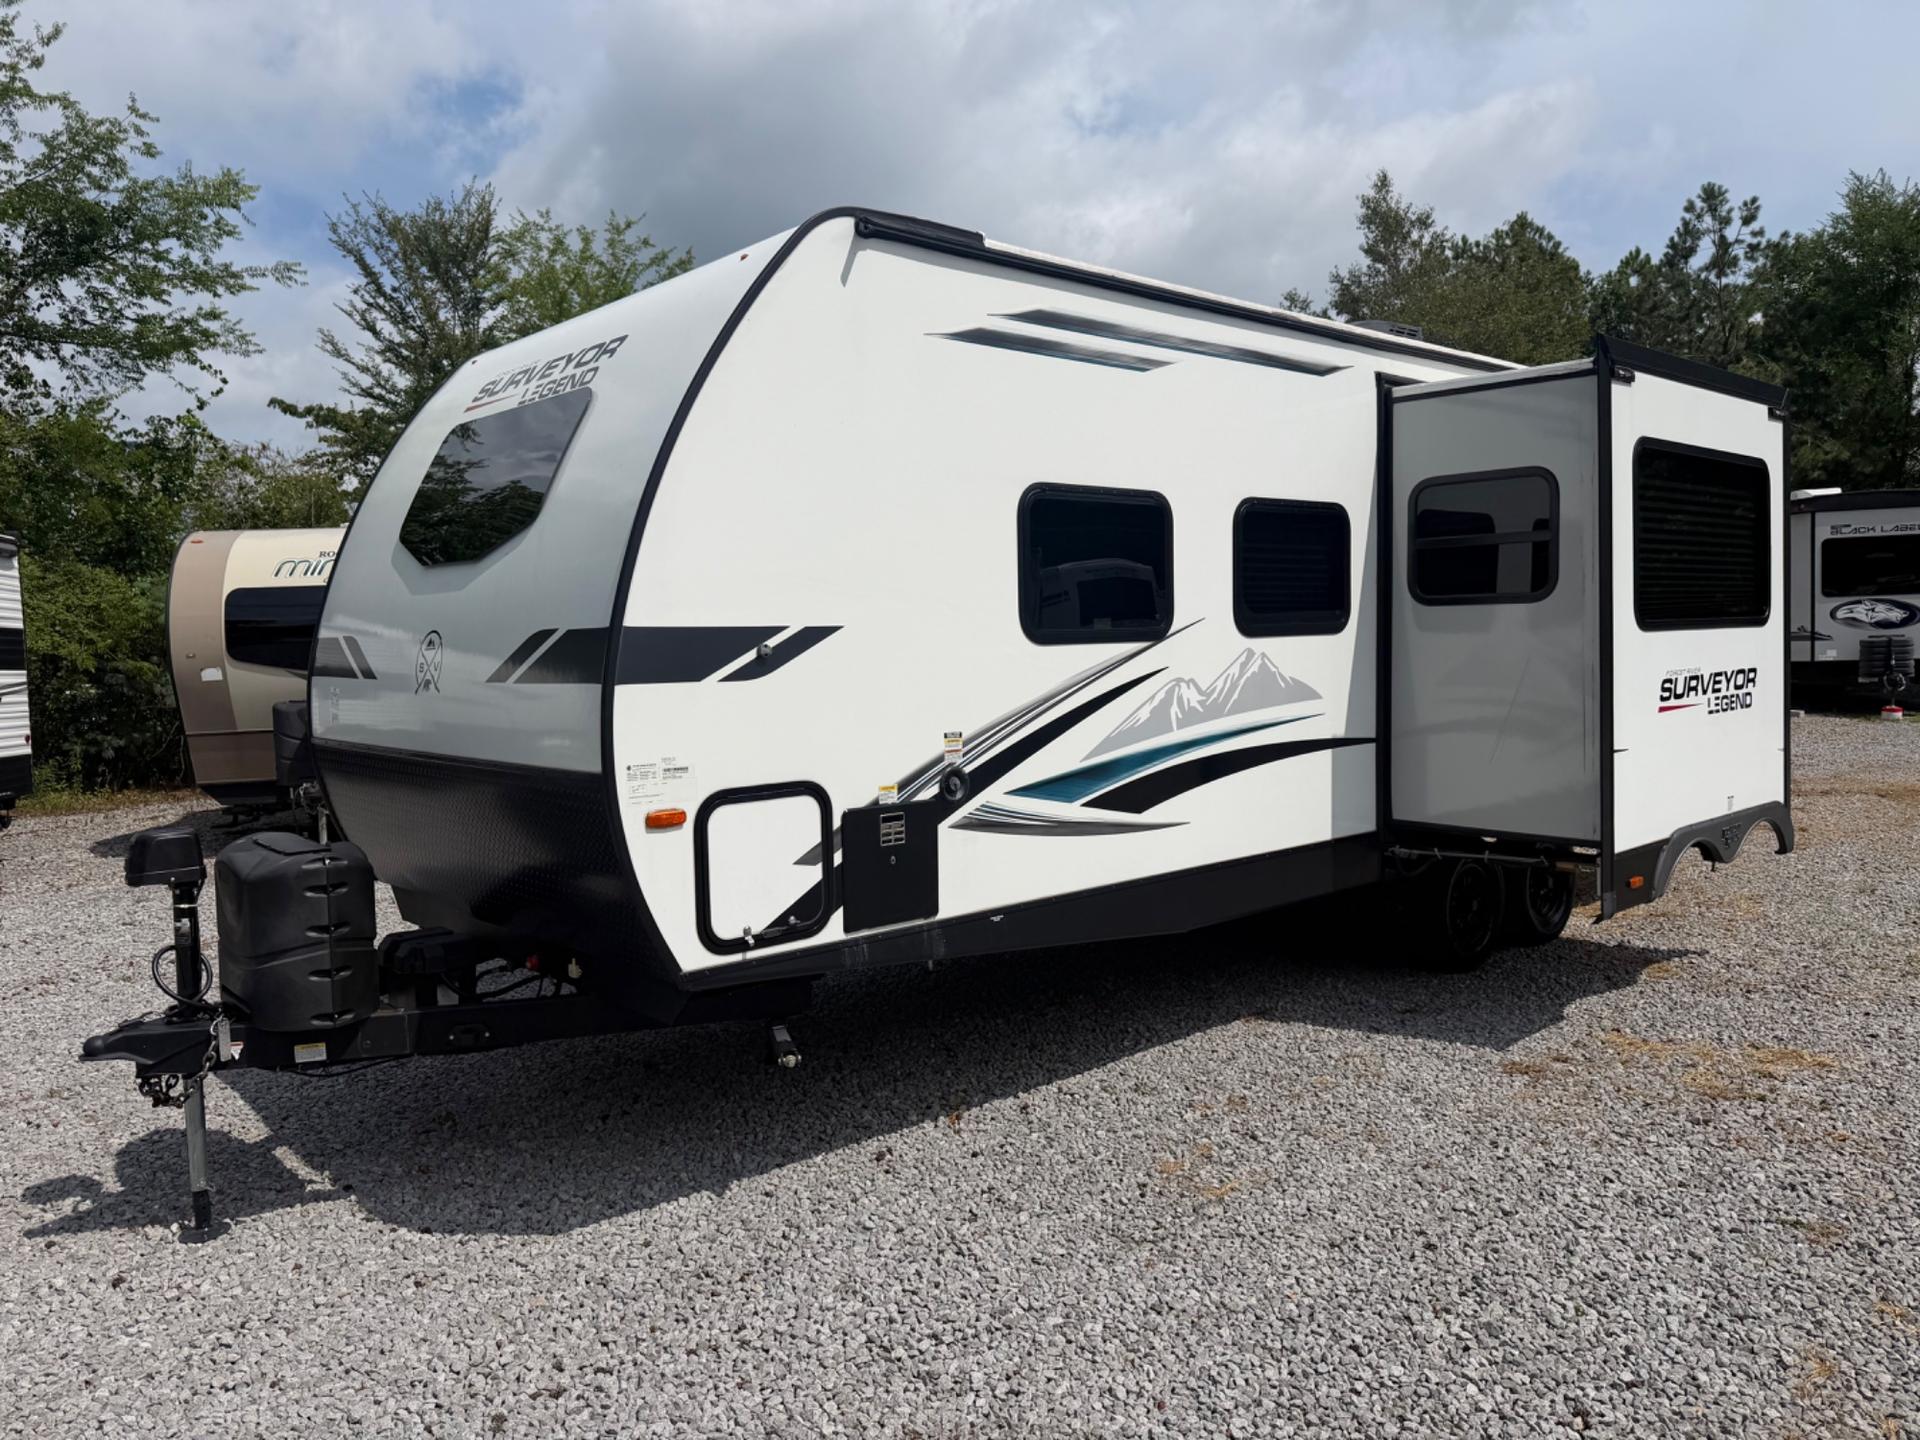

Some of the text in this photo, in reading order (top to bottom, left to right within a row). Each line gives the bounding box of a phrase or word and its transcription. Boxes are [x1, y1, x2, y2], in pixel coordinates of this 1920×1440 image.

[471, 334, 629, 403] SURVEYOR
[517, 366, 600, 406] LEGEND
[1830, 524, 1876, 535] BLACK
[1659, 667, 1757, 702] SURVEYOR
[1707, 691, 1753, 715] LEGEND
